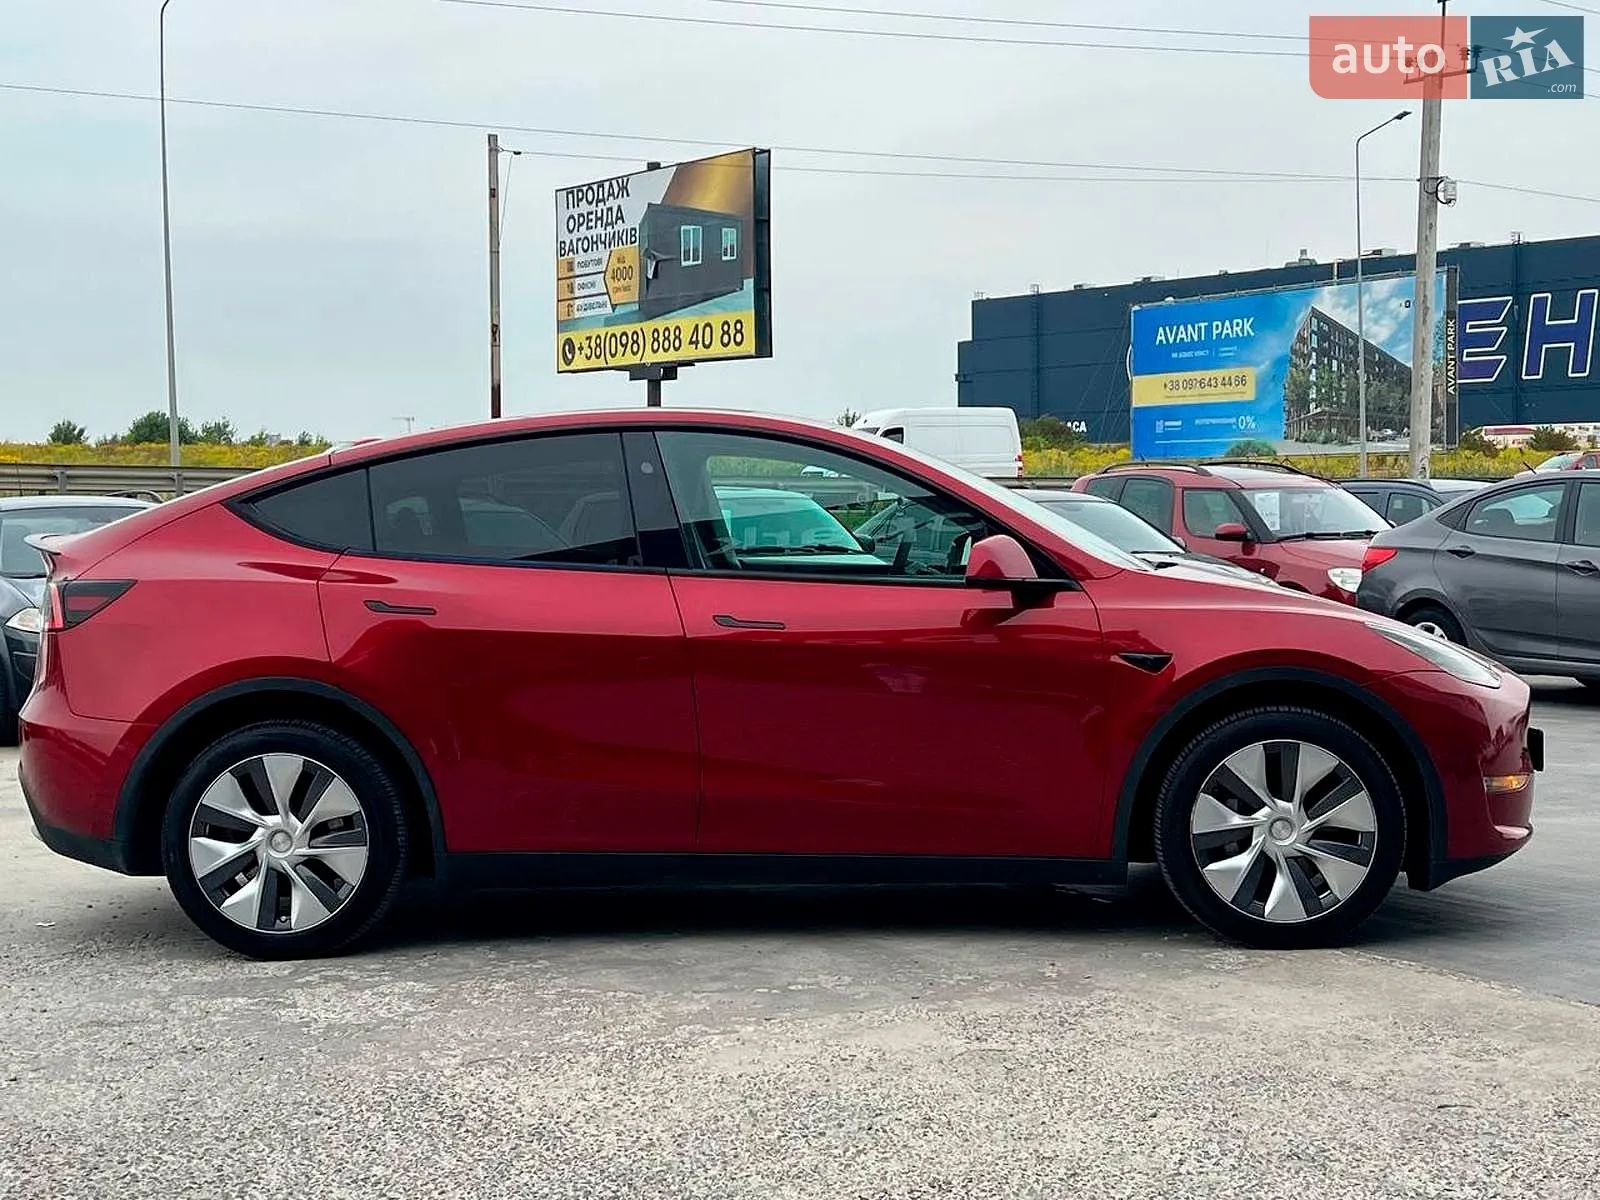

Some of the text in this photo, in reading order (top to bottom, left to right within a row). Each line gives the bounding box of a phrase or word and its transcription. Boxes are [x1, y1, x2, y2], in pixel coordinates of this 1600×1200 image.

[565, 177, 630, 210] ПРОДАЖ
[566, 204, 625, 234] ОРЕНДА
[559, 227, 638, 257] ВАГОНЧИКІВ
[611, 265, 634, 282] 4000
[577, 319, 744, 365] +38(098) 888 40 88
[1155, 316, 1255, 346] AVANT PARK
[1447, 319, 1456, 395] AVANT PARK
[1238, 415, 1256, 430] 0%
